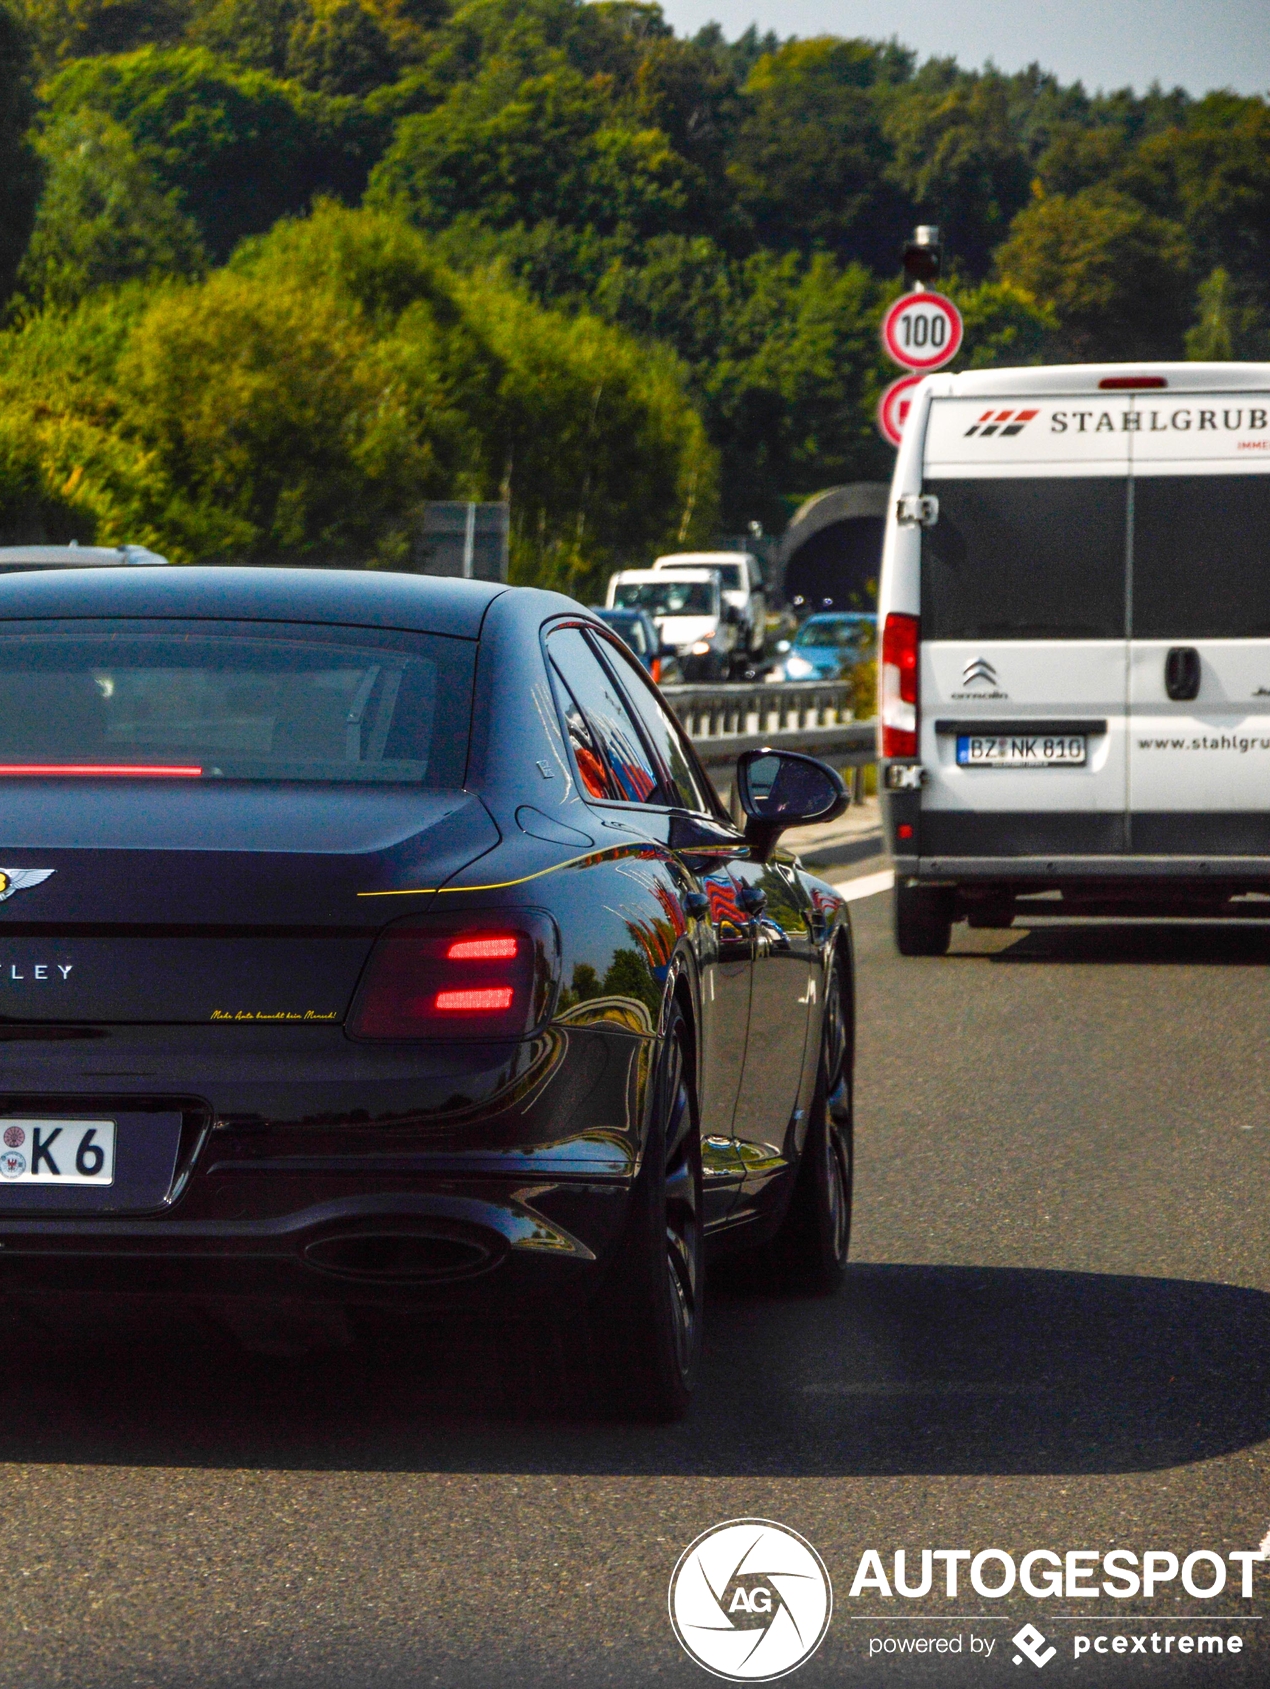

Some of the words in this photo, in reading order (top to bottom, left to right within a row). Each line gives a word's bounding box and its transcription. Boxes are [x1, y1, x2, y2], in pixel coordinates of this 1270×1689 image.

[902, 314, 946, 347] 100
[1050, 408, 1269, 433] STAHLGRUB
[1237, 441, 1270, 451] IMME
[971, 739, 998, 758] BZ
[1011, 739, 1037, 758] NK
[1043, 738, 1082, 758] 810
